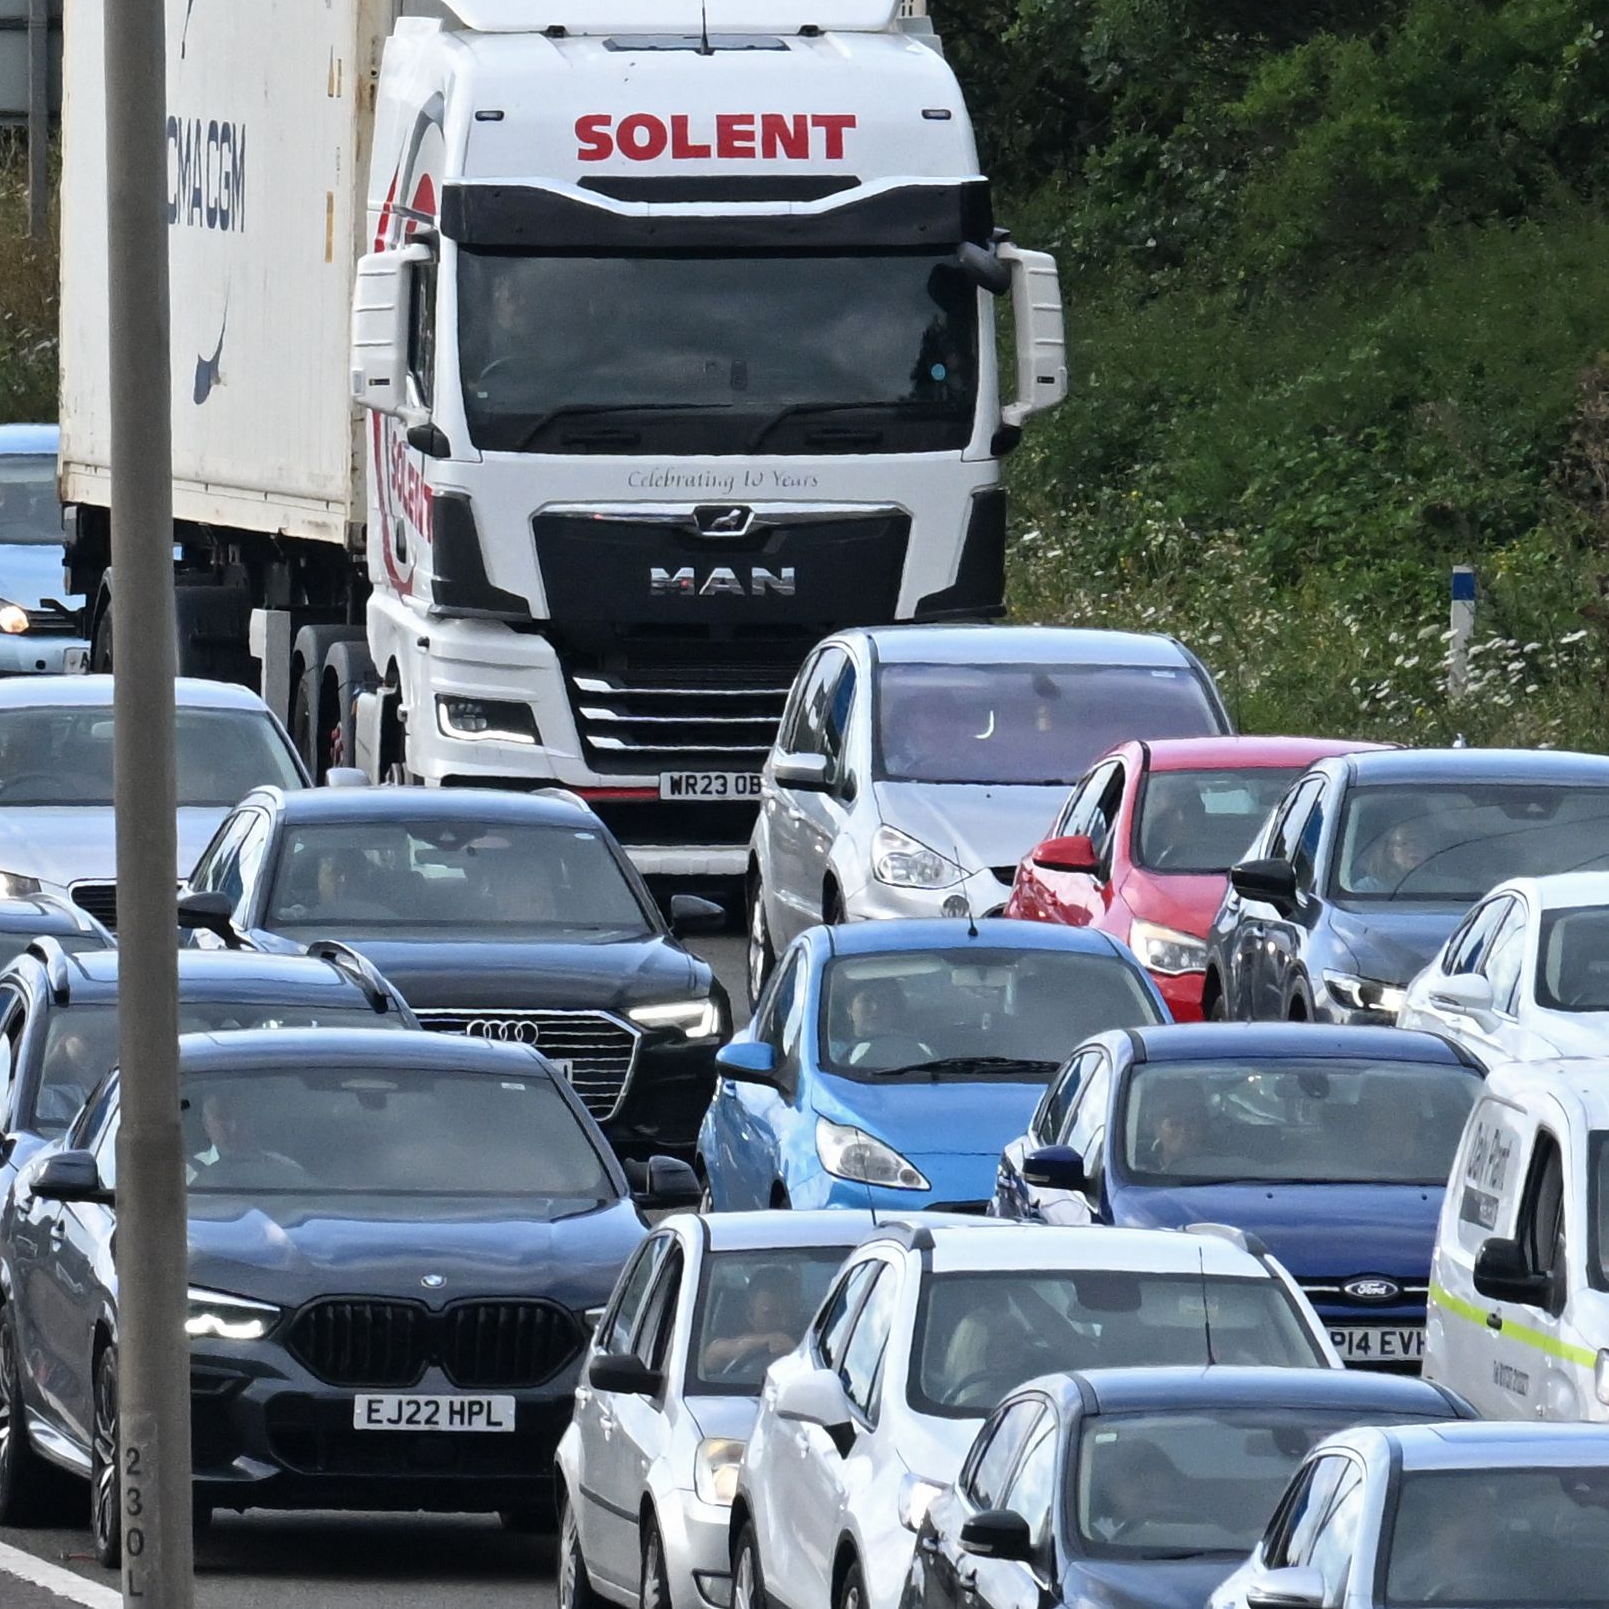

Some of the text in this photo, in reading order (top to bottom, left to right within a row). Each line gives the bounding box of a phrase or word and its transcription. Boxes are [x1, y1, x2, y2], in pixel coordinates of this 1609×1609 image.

[575, 112, 857, 162] SOLENT
[166, 115, 247, 234] CMA CGM
[627, 466, 819, 495] Celebrating 10 Years
[649, 566, 796, 596] MAN
[669, 774, 761, 796] WR23 OB
[1357, 1282, 1387, 1296] Ford
[366, 1399, 503, 1427] EJ22 HPL
[125, 1446, 145, 1598] 230L
